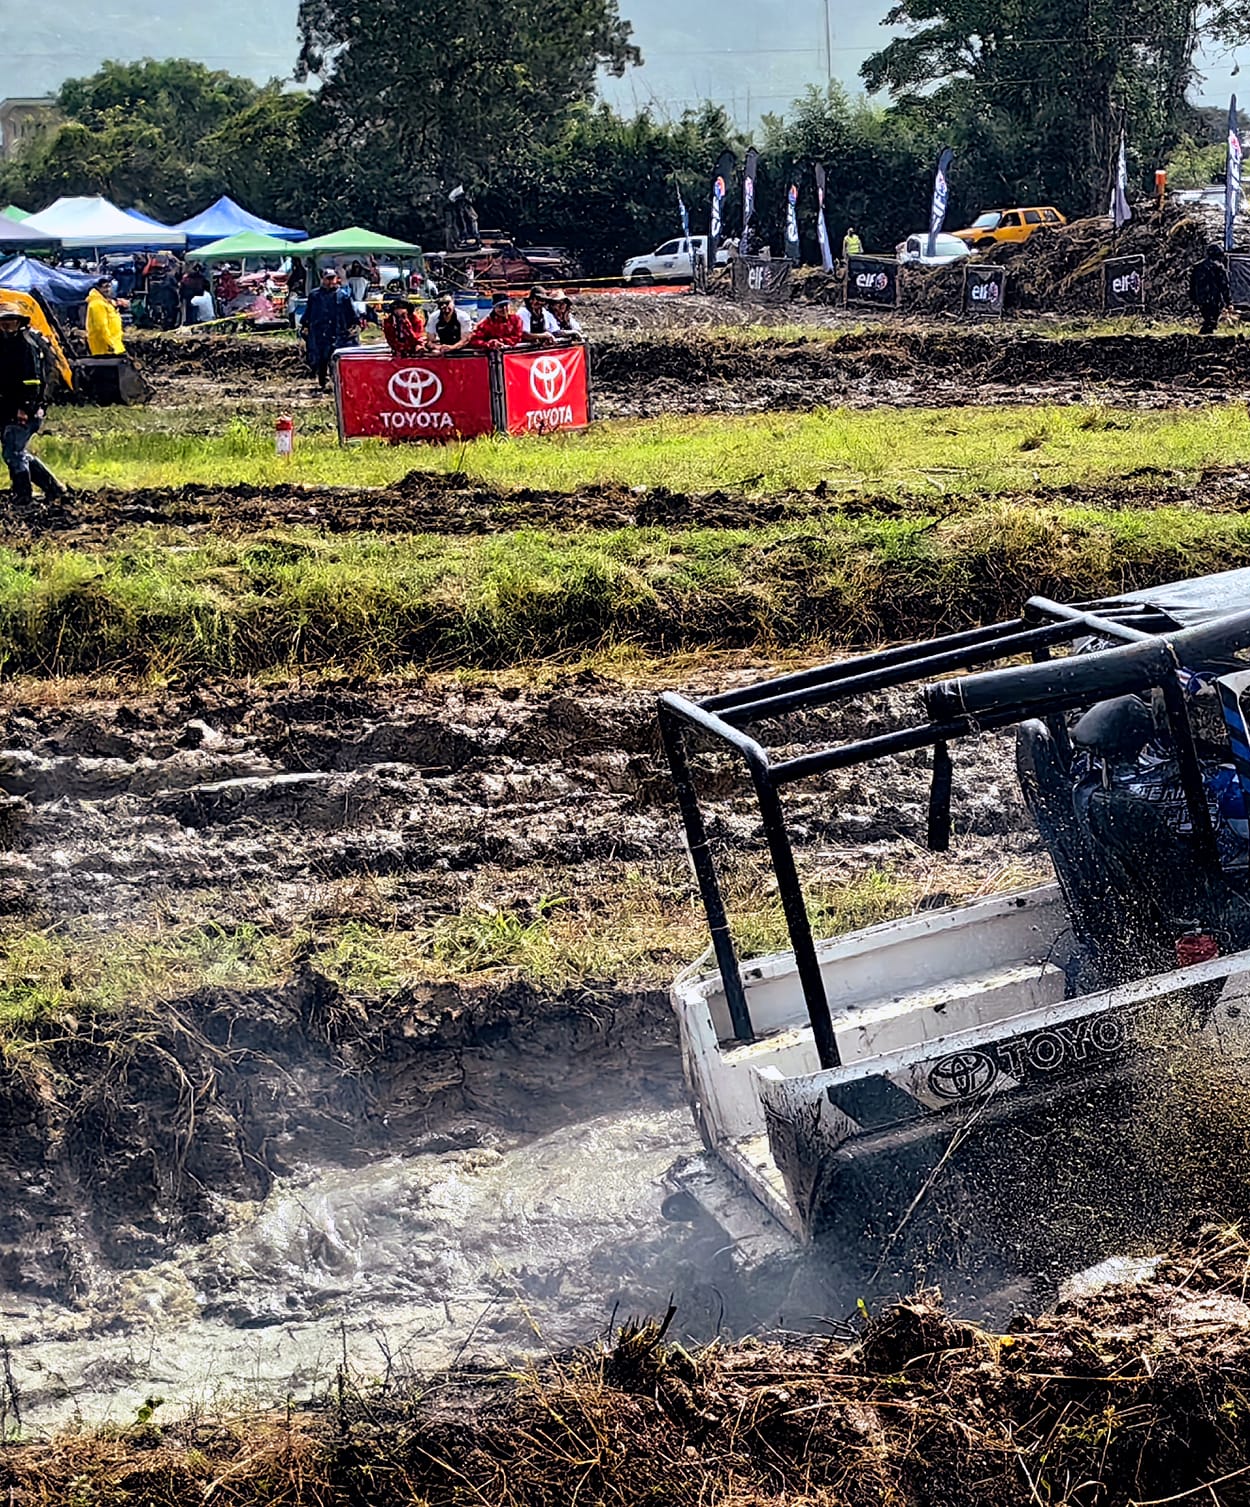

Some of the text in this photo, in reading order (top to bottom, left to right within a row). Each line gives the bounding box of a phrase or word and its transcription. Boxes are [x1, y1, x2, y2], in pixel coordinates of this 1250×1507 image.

[856, 273, 876, 287] elf
[1112, 275, 1131, 293] elf
[972, 284, 989, 300] elf
[380, 411, 454, 428] TOYOTA
[526, 405, 573, 429] TOYOTA
[999, 1008, 1150, 1079] TOYO
